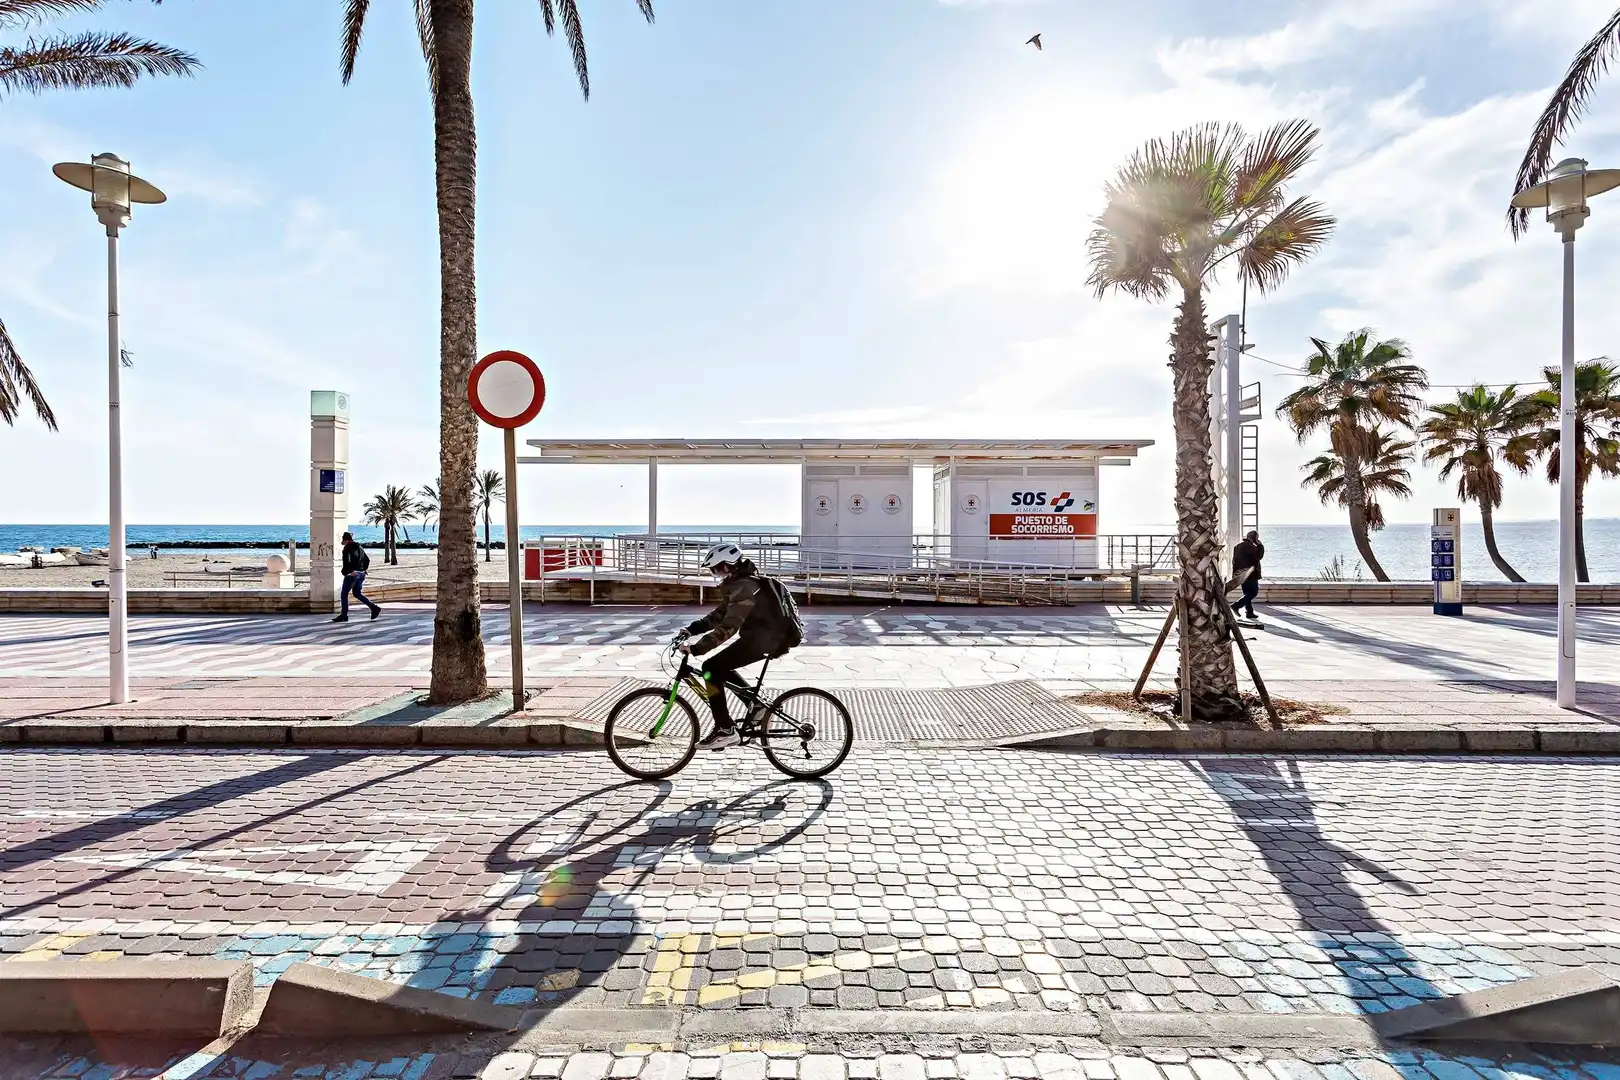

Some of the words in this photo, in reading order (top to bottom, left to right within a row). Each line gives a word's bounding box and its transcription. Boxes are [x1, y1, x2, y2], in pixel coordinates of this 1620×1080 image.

[1011, 492, 1047, 505] SOS
[1015, 516, 1053, 524] PUESTO
[1055, 516, 1068, 524] DE
[1011, 525, 1075, 534] SOCORRISMO
